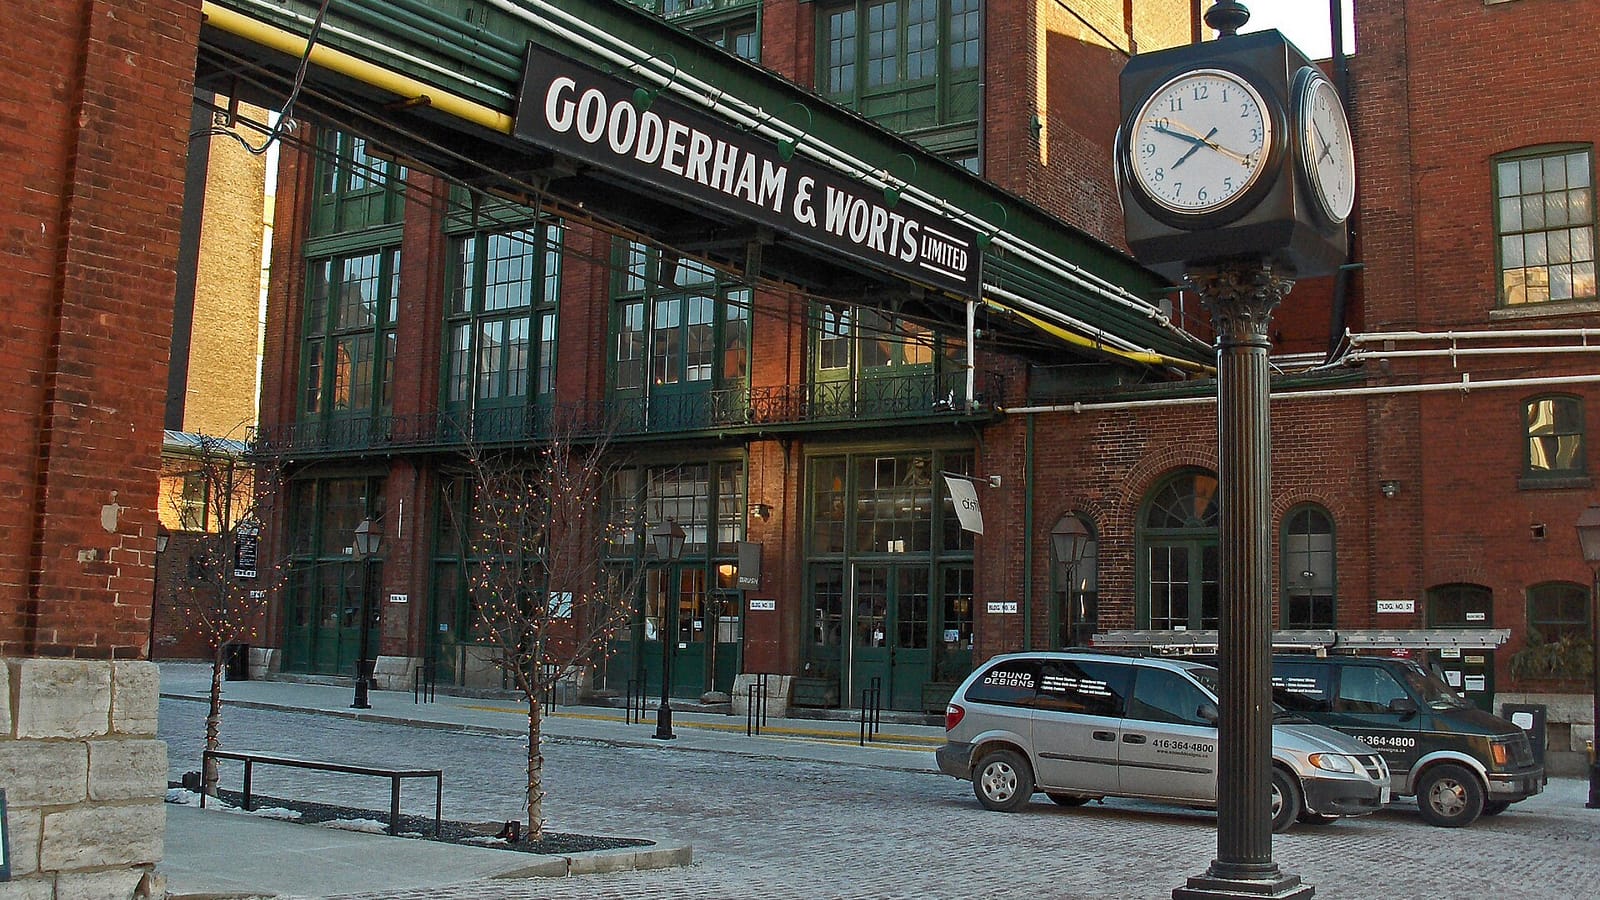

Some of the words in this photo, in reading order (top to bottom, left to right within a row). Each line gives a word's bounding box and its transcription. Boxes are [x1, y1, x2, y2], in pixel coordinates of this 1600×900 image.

[1193, 86, 1208, 100] 12
[1222, 89, 1228, 103] 1
[1170, 97, 1183, 112] 11
[1241, 104, 1249, 117] 2
[1155, 117, 1169, 132] 10
[1250, 129, 1258, 143] 3
[1146, 144, 1156, 157] 9
[1242, 154, 1250, 168] 4
[545, 77, 788, 214] GOODERHAM
[794, 176, 816, 228] &
[825, 185, 920, 263] WORTS
[1155, 167, 1164, 181] 8
[1174, 183, 1182, 197] 7
[1223, 177, 1232, 191] 5
[1198, 186, 1207, 200] 6
[921, 235, 967, 272] LIMITED
[983, 677, 1035, 688] DESIGNS
[991, 670, 1032, 681] SOUND
